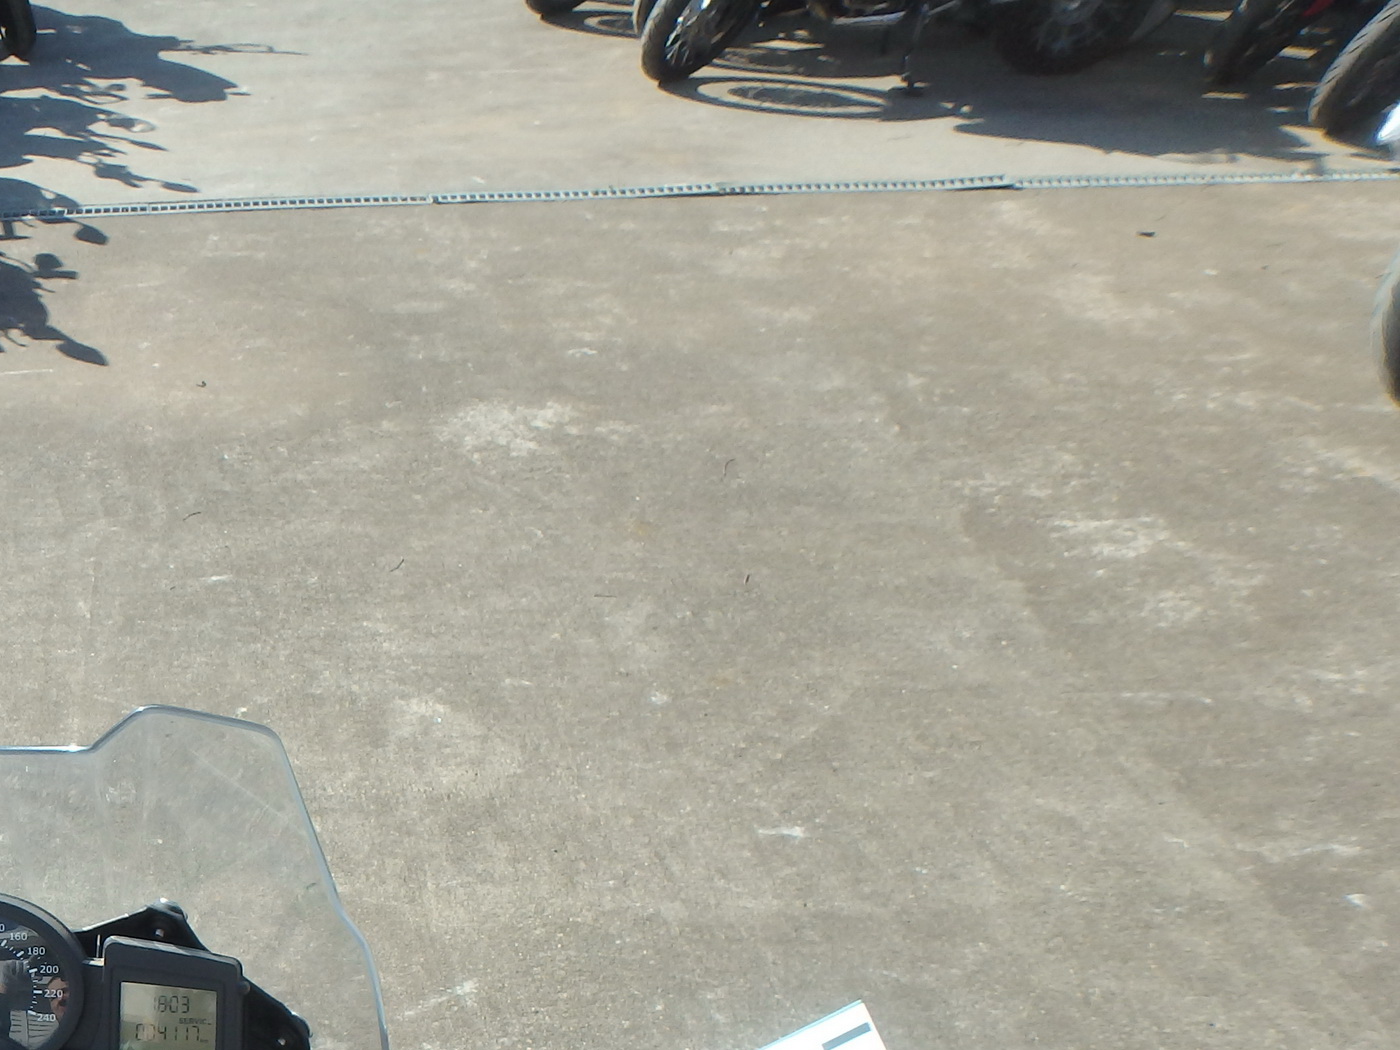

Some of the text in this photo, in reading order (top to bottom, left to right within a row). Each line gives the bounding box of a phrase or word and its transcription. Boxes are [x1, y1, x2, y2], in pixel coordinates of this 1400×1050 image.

[9, 932, 28, 941] 160
[27, 947, 46, 956] 180
[40, 965, 59, 974] 200
[44, 989, 64, 999] 220
[37, 1014, 56, 1022] 240
